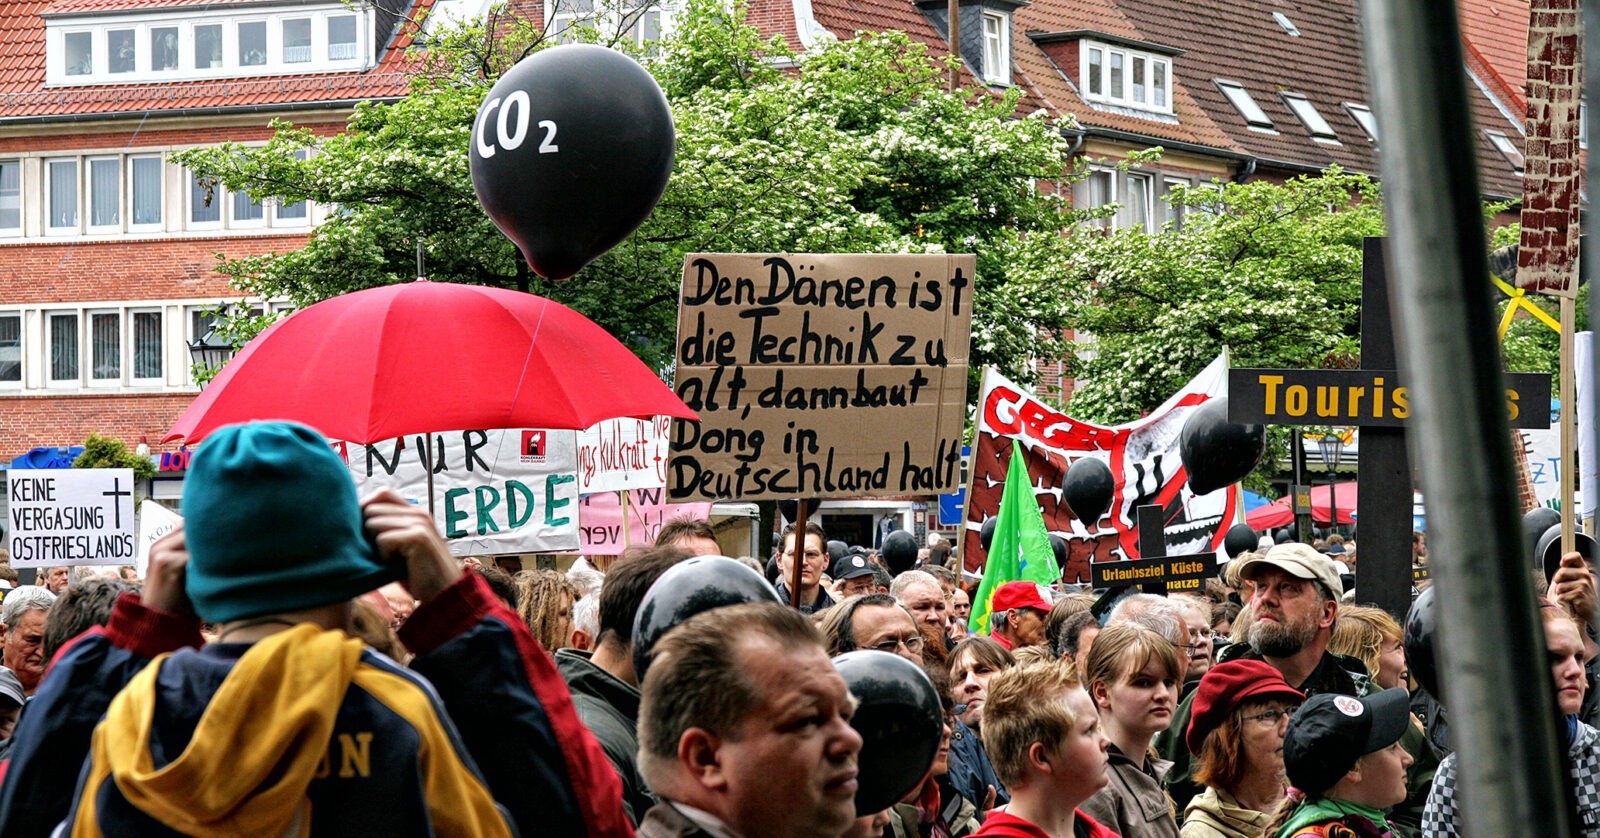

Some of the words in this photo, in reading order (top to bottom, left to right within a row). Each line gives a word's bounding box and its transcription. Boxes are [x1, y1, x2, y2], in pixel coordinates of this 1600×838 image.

[683, 258, 755, 306] Den
[757, 257, 897, 310] Dänen
[908, 267, 969, 316] ist
[681, 311, 737, 365] die
[739, 306, 886, 365] Technik
[889, 334, 948, 368] zu
[677, 366, 751, 420] alt,
[1258, 374, 1520, 421] Touriss
[365, 430, 491, 477] NUR
[670, 418, 765, 462] Dong
[783, 421, 819, 454] in
[11, 478, 56, 501] KEINE
[670, 446, 890, 498] Deutschland
[899, 438, 960, 492] halt
[12, 506, 104, 531] VERGASUNG
[445, 474, 575, 539] ERDE
[13, 532, 133, 560] OSTFRIESLAND'S
[1102, 564, 1164, 581] Urlaubsziel
[1171, 561, 1204, 575] Küste
